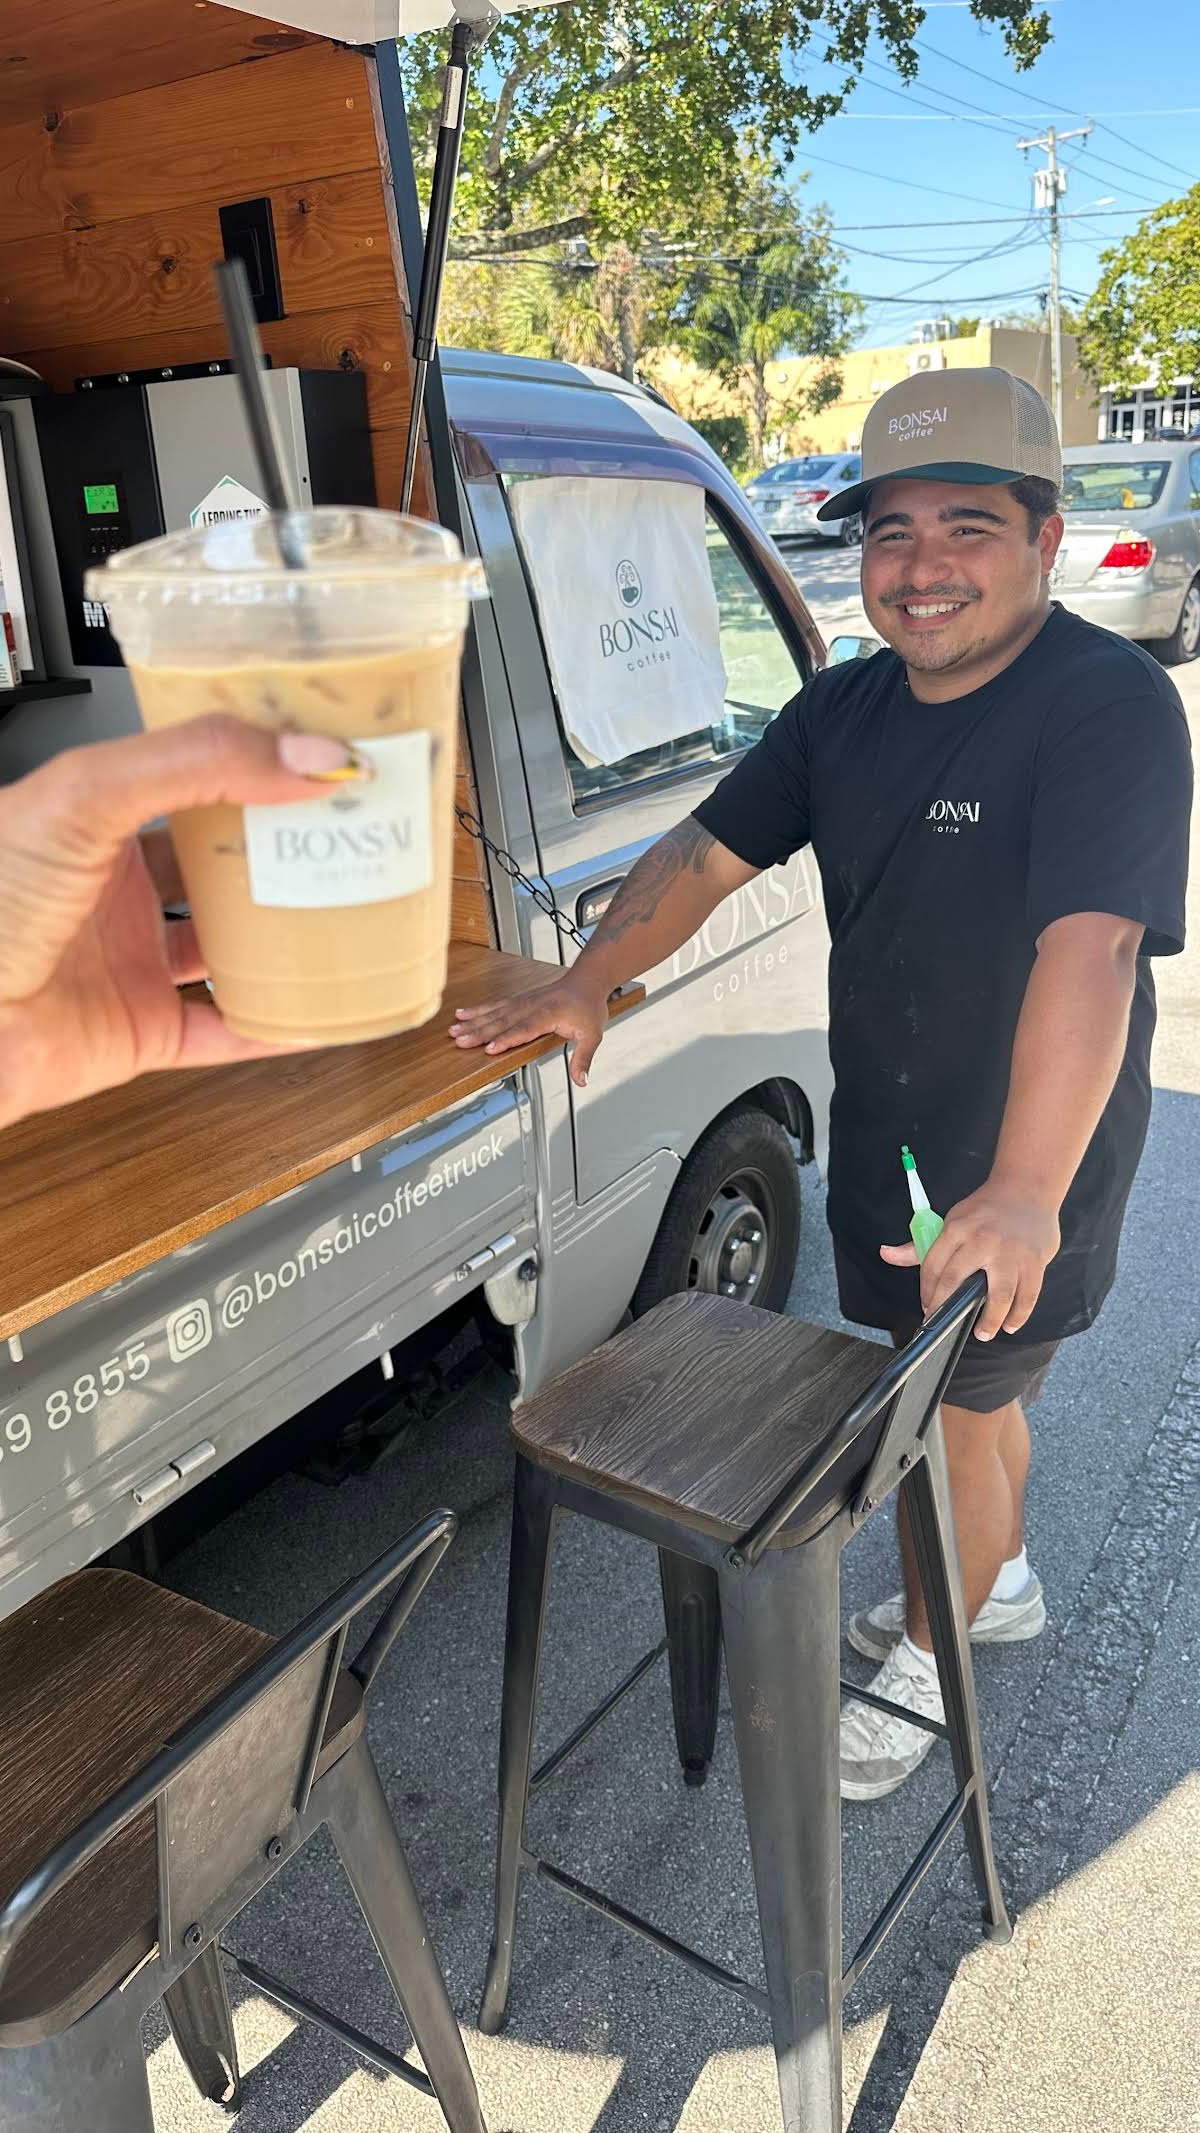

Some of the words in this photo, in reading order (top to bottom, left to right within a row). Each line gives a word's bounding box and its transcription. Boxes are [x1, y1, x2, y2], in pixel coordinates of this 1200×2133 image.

[888, 407, 947, 434] BONSAI
[899, 427, 934, 441] coffee
[600, 606, 679, 657] BONSAI
[627, 650, 671, 672] coffee
[713, 944, 789, 1002] coffee
[0, 1413, 32, 1464] 9
[45, 1341, 151, 1430] 8855
[221, 1133, 505, 1329] @bonsaicoffeetruck
